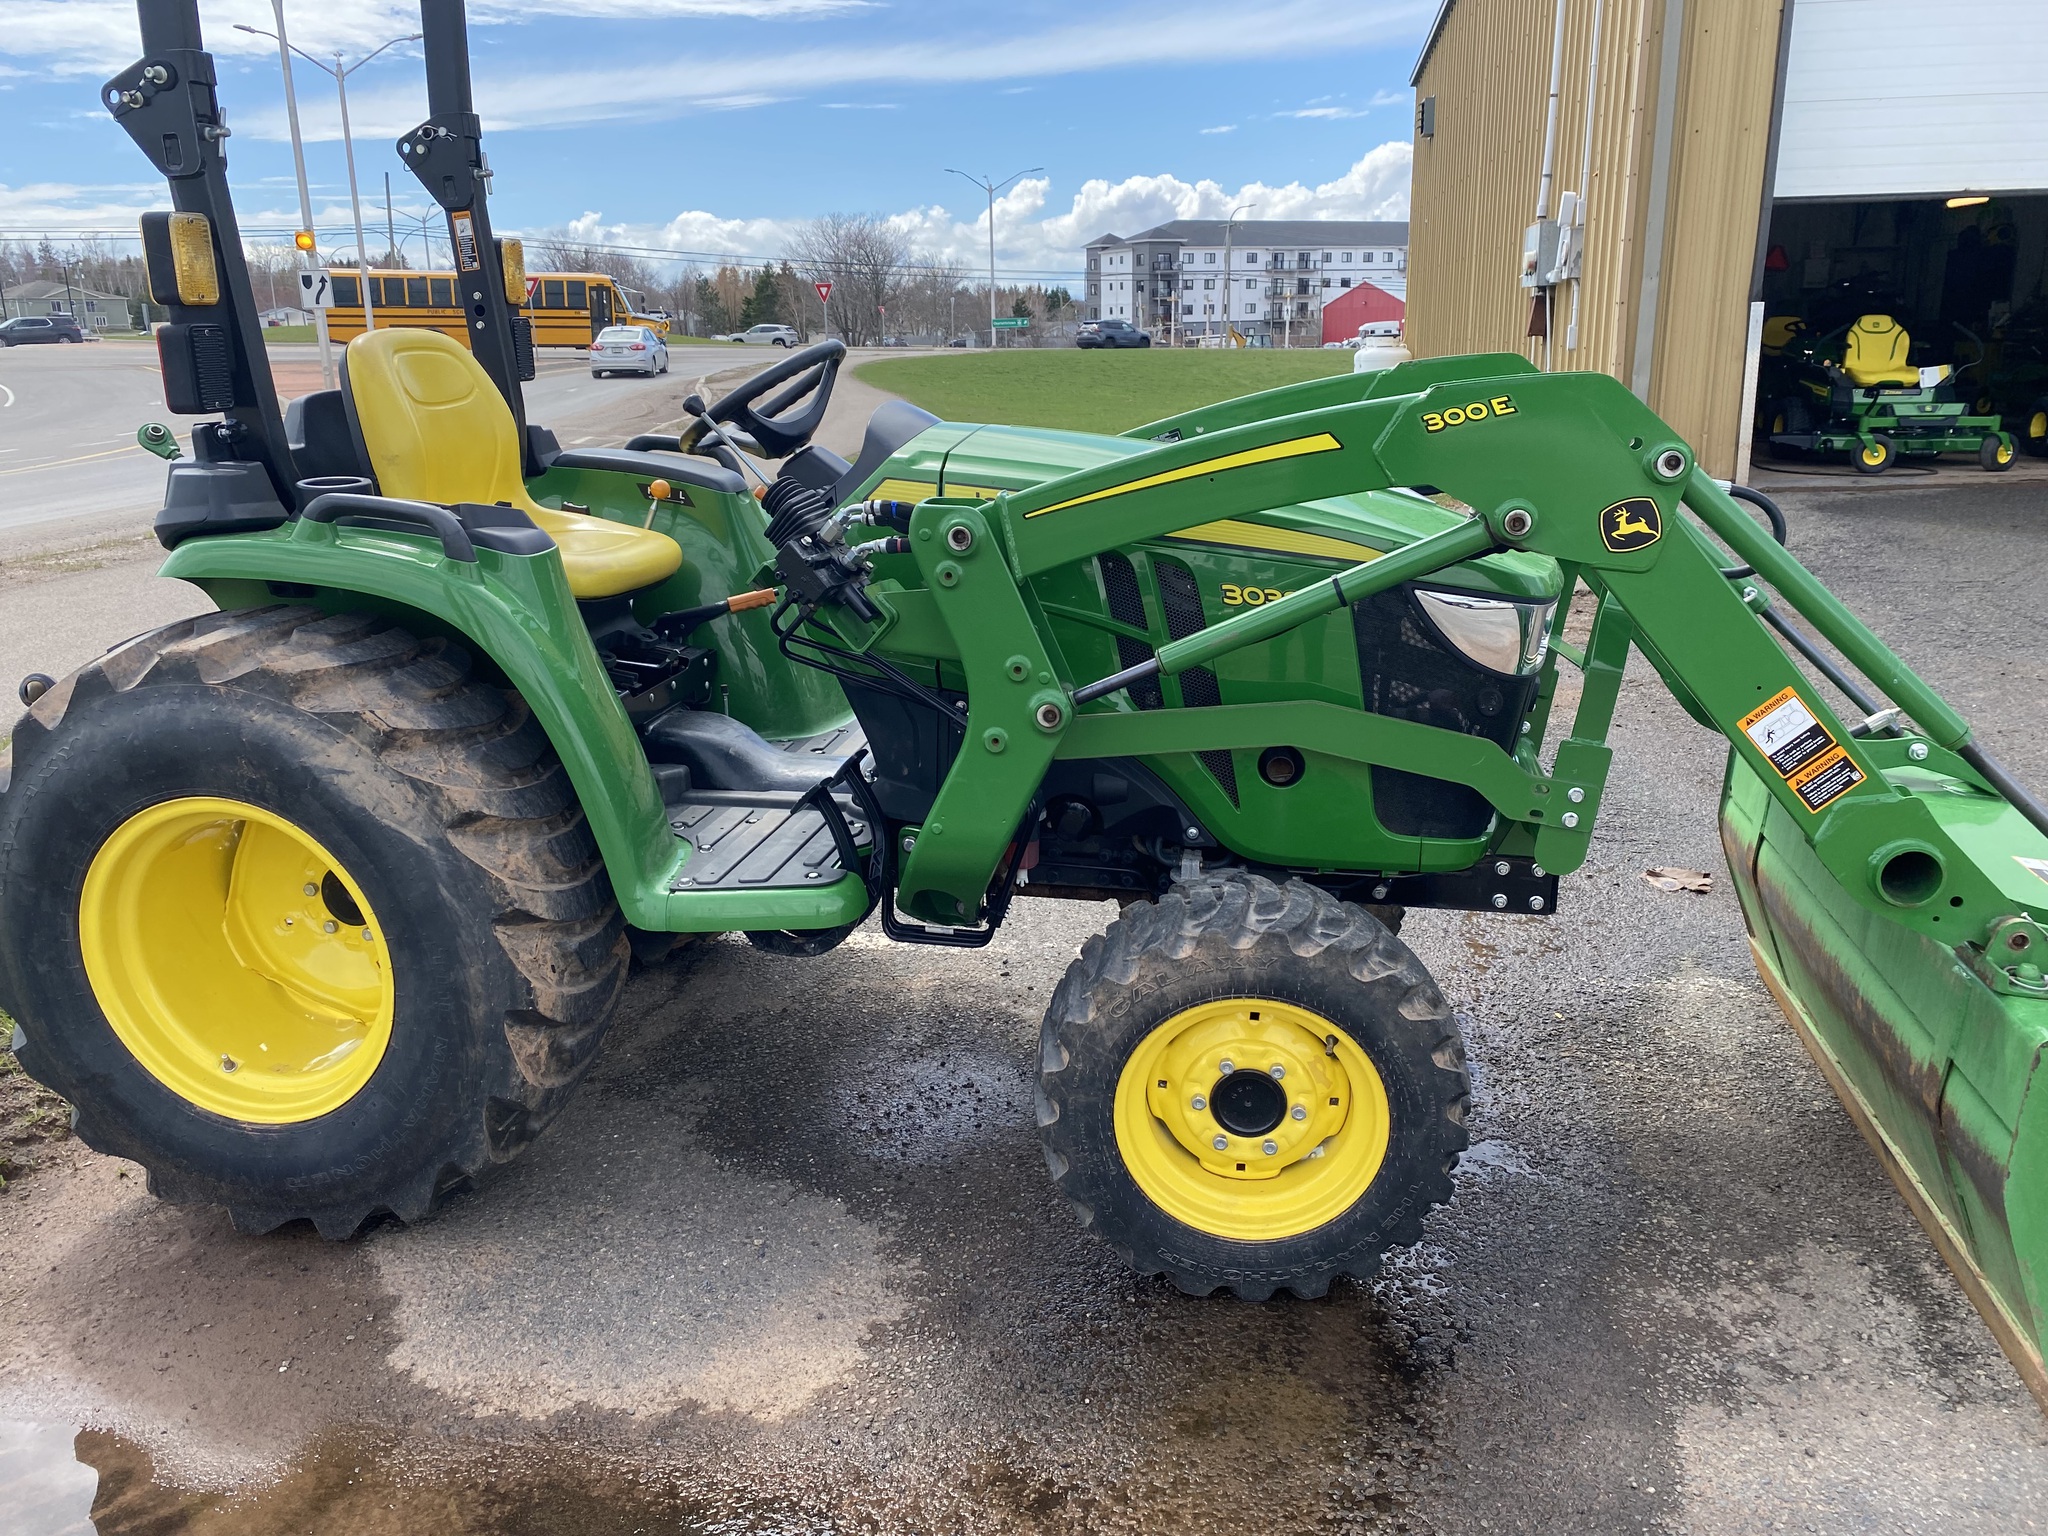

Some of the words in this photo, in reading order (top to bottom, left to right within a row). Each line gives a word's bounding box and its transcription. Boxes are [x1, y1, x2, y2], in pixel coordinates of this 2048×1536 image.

[1220, 583, 1296, 606] 303
[1753, 692, 1789, 720] WARNING
[1804, 752, 1840, 779] WARNING
[1109, 956, 1278, 1018] GALAXY
[1157, 1231, 1380, 1282] MARATHONER
